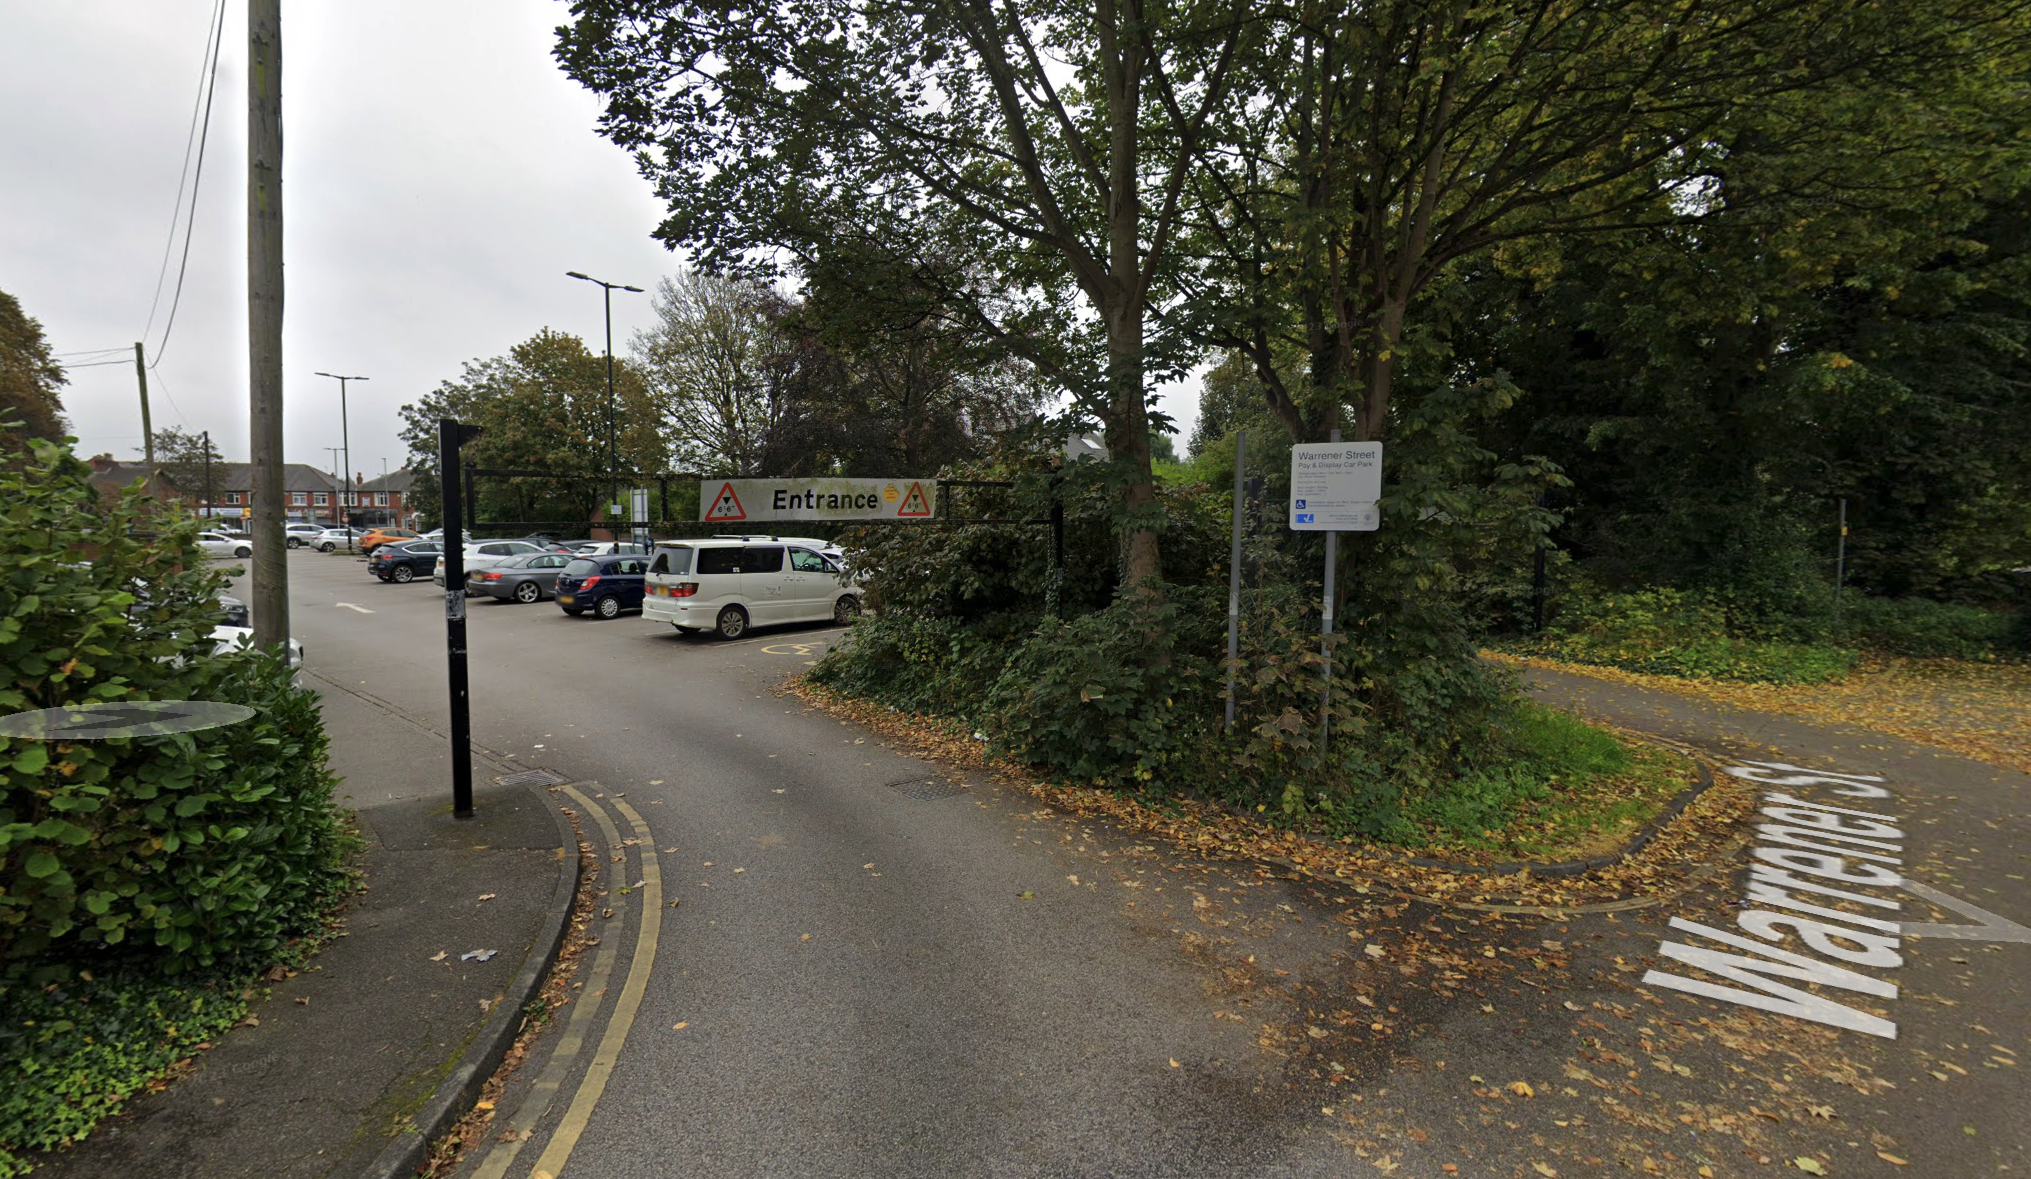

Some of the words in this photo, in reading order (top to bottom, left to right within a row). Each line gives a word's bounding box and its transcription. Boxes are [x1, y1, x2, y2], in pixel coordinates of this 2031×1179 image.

[1298, 452, 1343, 460] Warrener
[1345, 450, 1376, 460] Street
[1318, 461, 1342, 469] Display
[773, 489, 878, 510] Entrance
